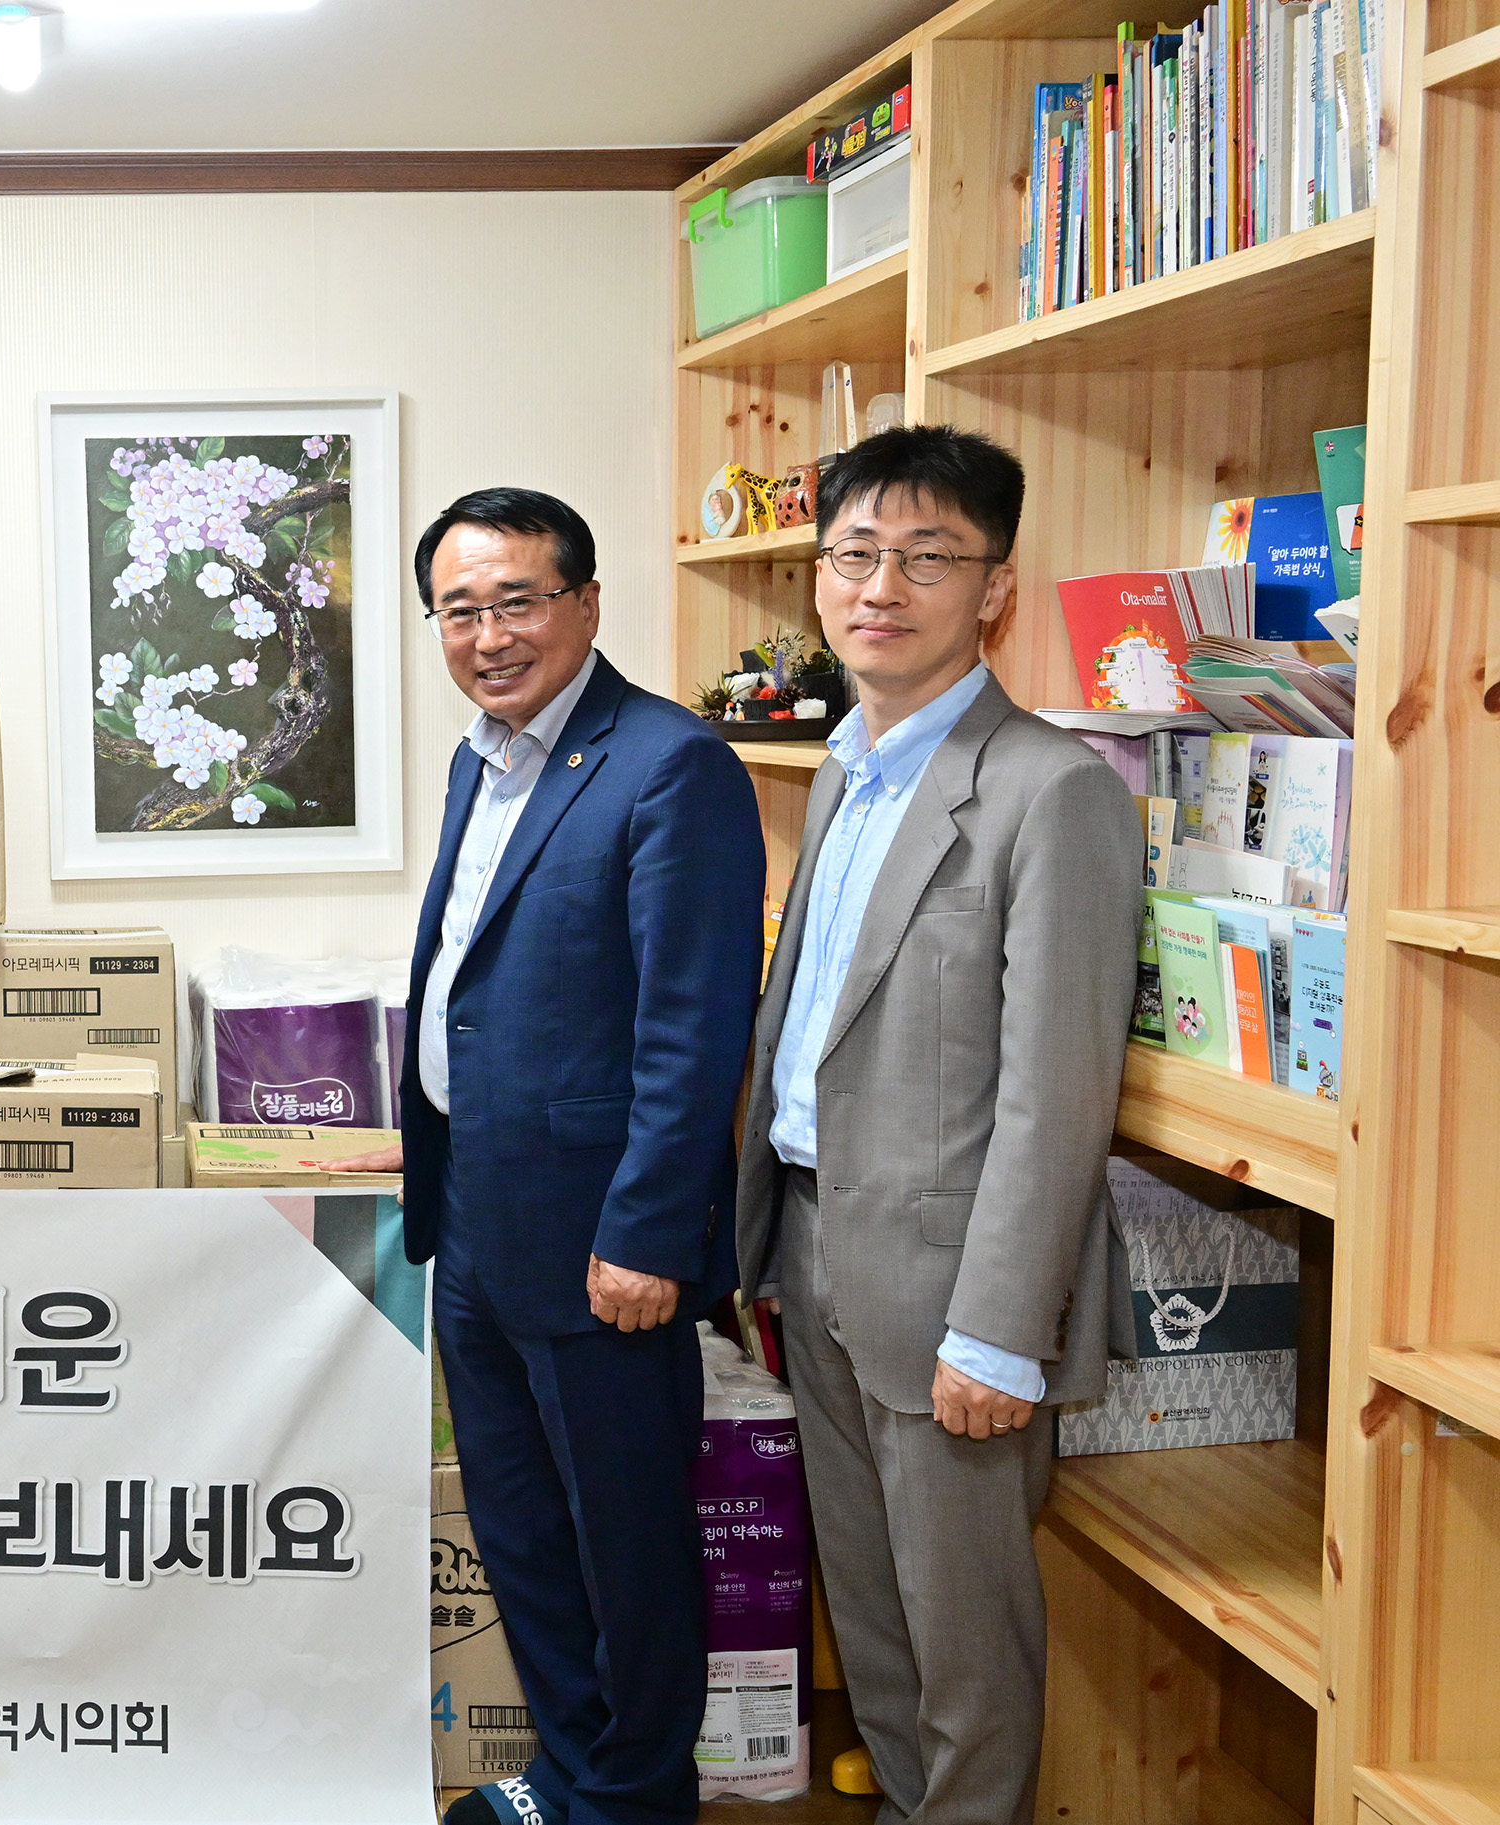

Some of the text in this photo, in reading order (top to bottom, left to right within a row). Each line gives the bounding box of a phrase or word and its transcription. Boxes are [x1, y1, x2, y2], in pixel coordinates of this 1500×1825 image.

[1291, 546, 1317, 559] 두어야
[1274, 564, 1300, 576] 가족법
[1120, 590, 1168, 606] Ota-onalar
[2, 957, 80, 972] 아모레퍼시픽
[94, 960, 122, 971] 11129
[132, 960, 155, 970] 2364
[259, 1088, 344, 1121] 잘풀리는집
[67, 1111, 98, 1122] 11129
[110, 1111, 135, 1123] 2364
[1118, 1357, 1221, 1374] METROPOLITAN
[1225, 1353, 1285, 1367] COUNCIL
[755, 1437, 797, 1454] 잘풀리는집
[720, 1501, 759, 1514] Q.S.P
[703, 1524, 784, 1541] 집이 약속하는
[703, 1547, 726, 1560] 가치
[481, 1761, 530, 1772] 114609
